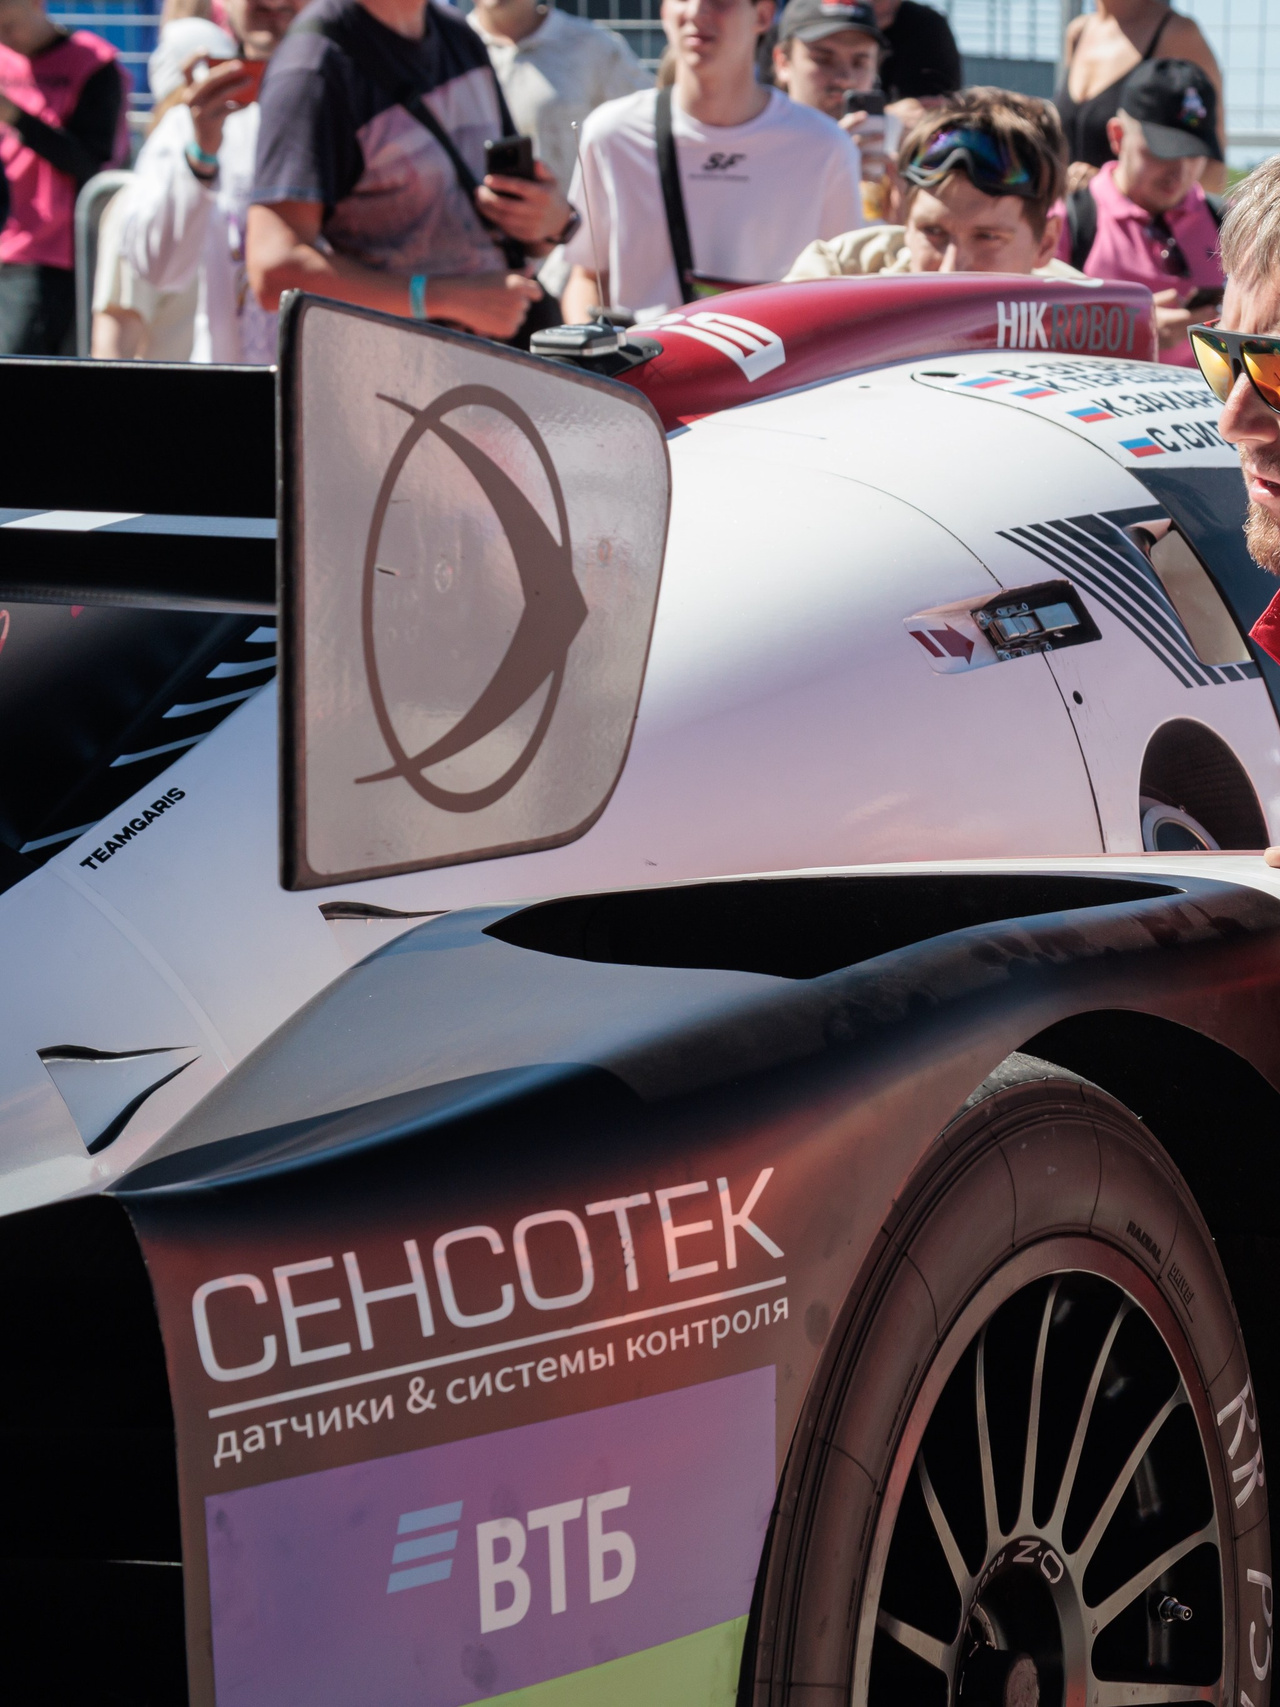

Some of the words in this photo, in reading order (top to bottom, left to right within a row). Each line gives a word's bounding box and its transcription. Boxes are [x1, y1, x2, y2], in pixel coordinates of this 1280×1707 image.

[996, 301, 1141, 352] HIKROBOT
[1091, 390, 1218, 417] К.ЗАХАР
[79, 787, 186, 870] TEAMGARIS
[192, 1167, 785, 1383] СЕНСОТЕК
[213, 1394, 395, 1468] датчики
[406, 1376, 437, 1414] &
[446, 1342, 615, 1405] системы
[626, 1297, 789, 1361] контроля
[476, 1485, 637, 1635] ВТБ
